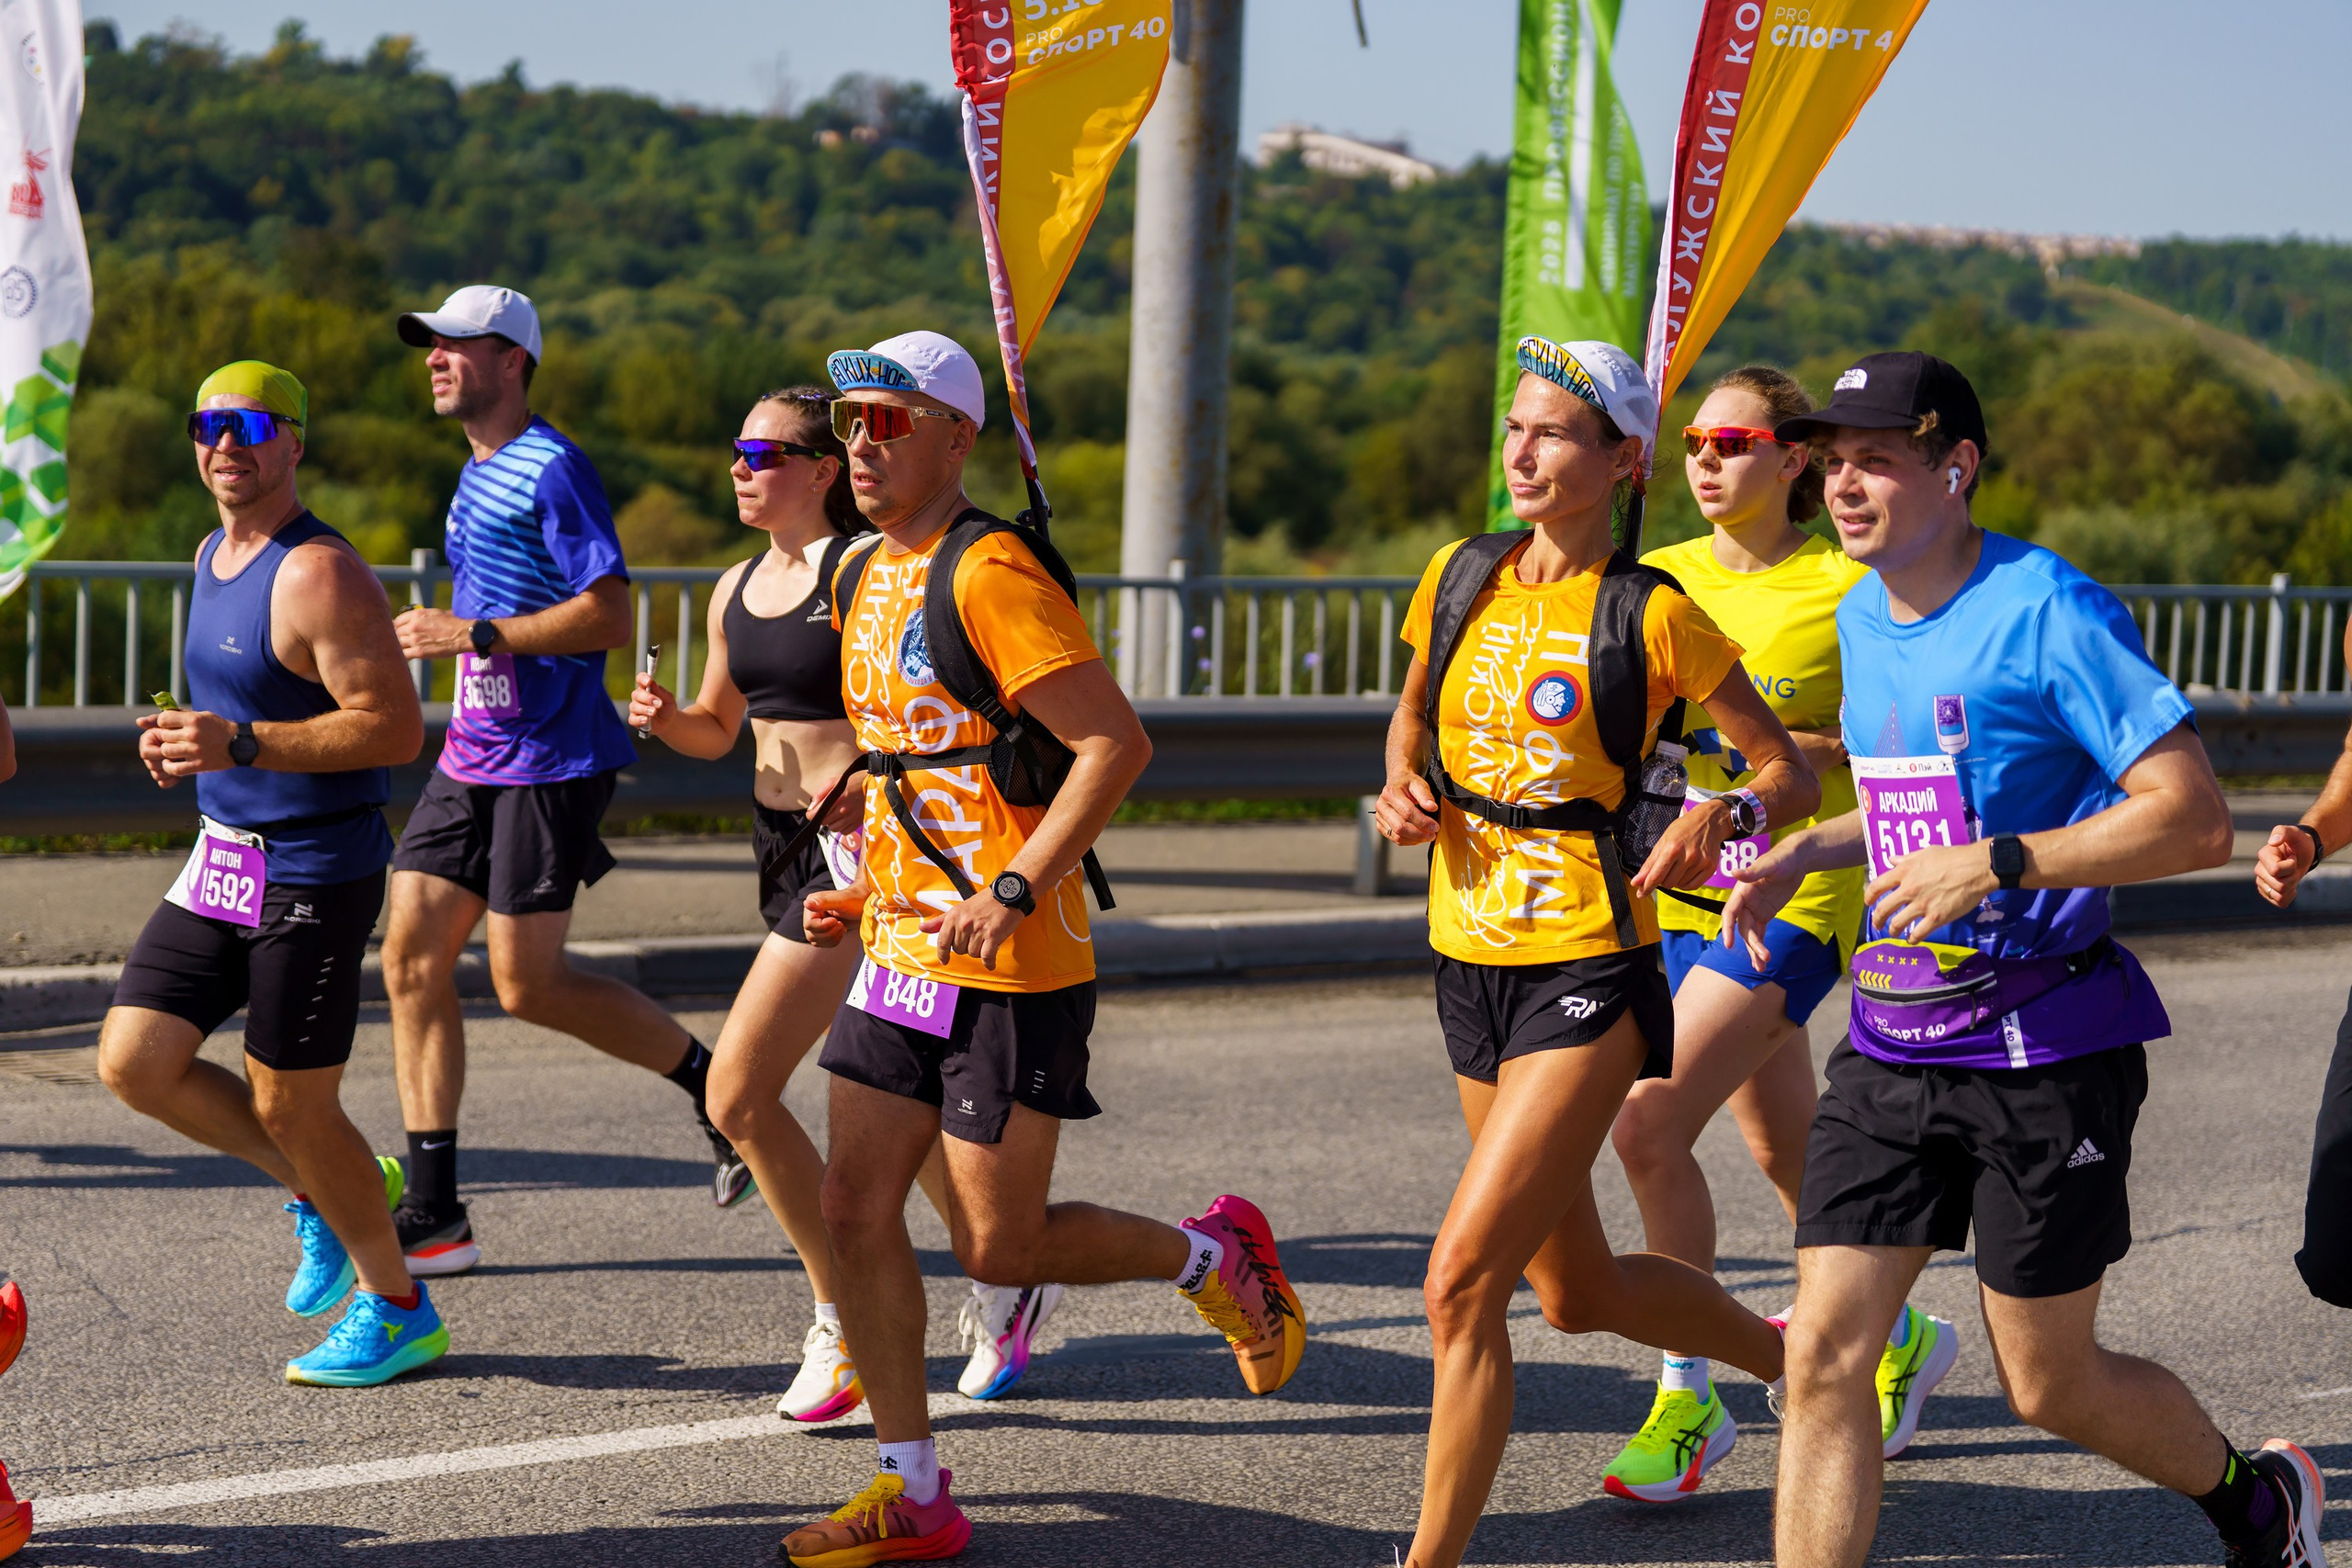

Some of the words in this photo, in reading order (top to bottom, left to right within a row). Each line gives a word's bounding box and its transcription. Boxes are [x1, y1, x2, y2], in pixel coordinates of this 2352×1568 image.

[1774, 6, 1811, 22] PRO
[1025, 27, 1063, 47] PRO
[1027, 24, 1125, 65] СПОРТ
[1129, 17, 1166, 40] 40
[1770, 25, 1870, 51] СПОРТ
[464, 674, 511, 709] 3698
[1747, 672, 1796, 699] NG
[1879, 787, 1938, 815] АРКАДИЙ
[1877, 818, 1952, 869] 5131
[209, 848, 242, 869] АНТОН
[199, 867, 255, 914] 1592
[884, 970, 938, 1018] 848
[1873, 1016, 1888, 1028] PRO
[1878, 1026, 1922, 1041] СПОРТ
[1925, 1023, 1946, 1038] 40
[2067, 1153, 2105, 1168] adidas
